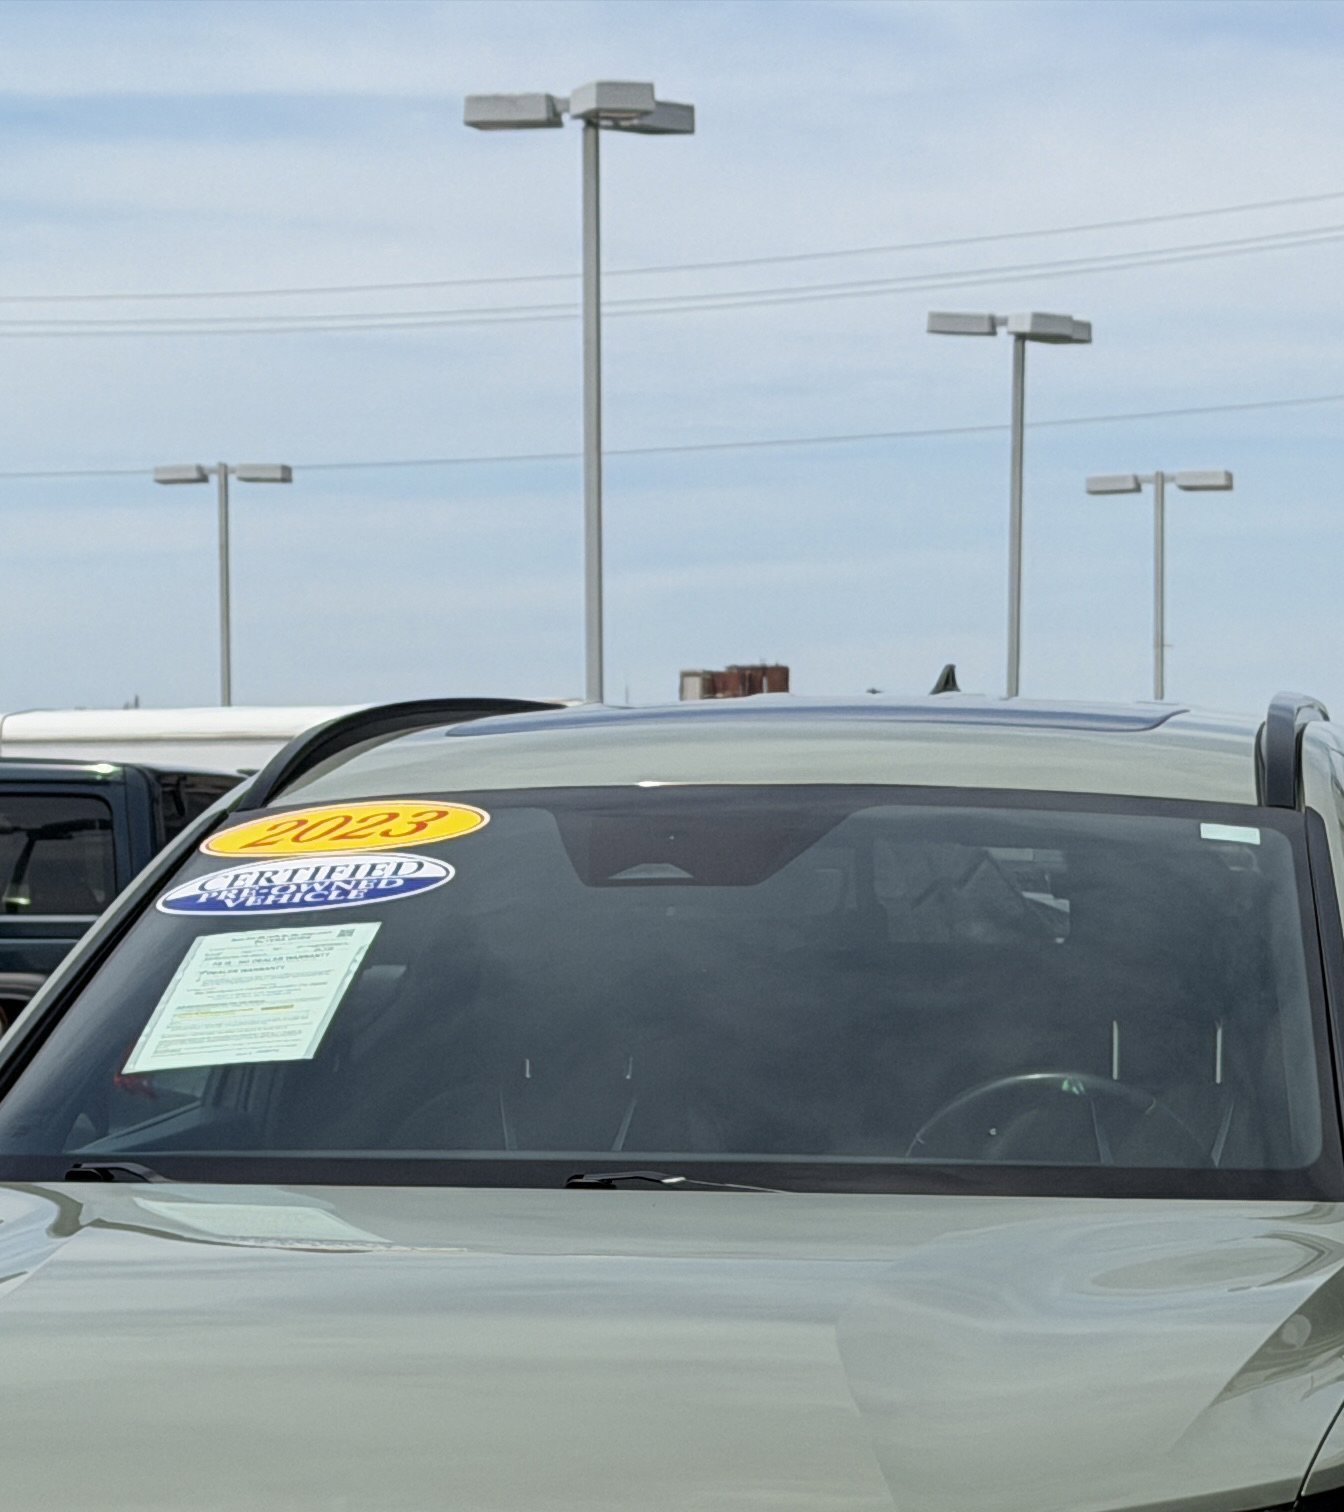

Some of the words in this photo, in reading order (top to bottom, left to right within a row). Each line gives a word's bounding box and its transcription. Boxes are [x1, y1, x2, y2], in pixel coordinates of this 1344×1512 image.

[239, 810, 449, 849] 2023
[196, 877, 405, 904] PRE-OWNED
[197, 860, 425, 893] CERTIFIED
[223, 888, 369, 909] VEHICLE
